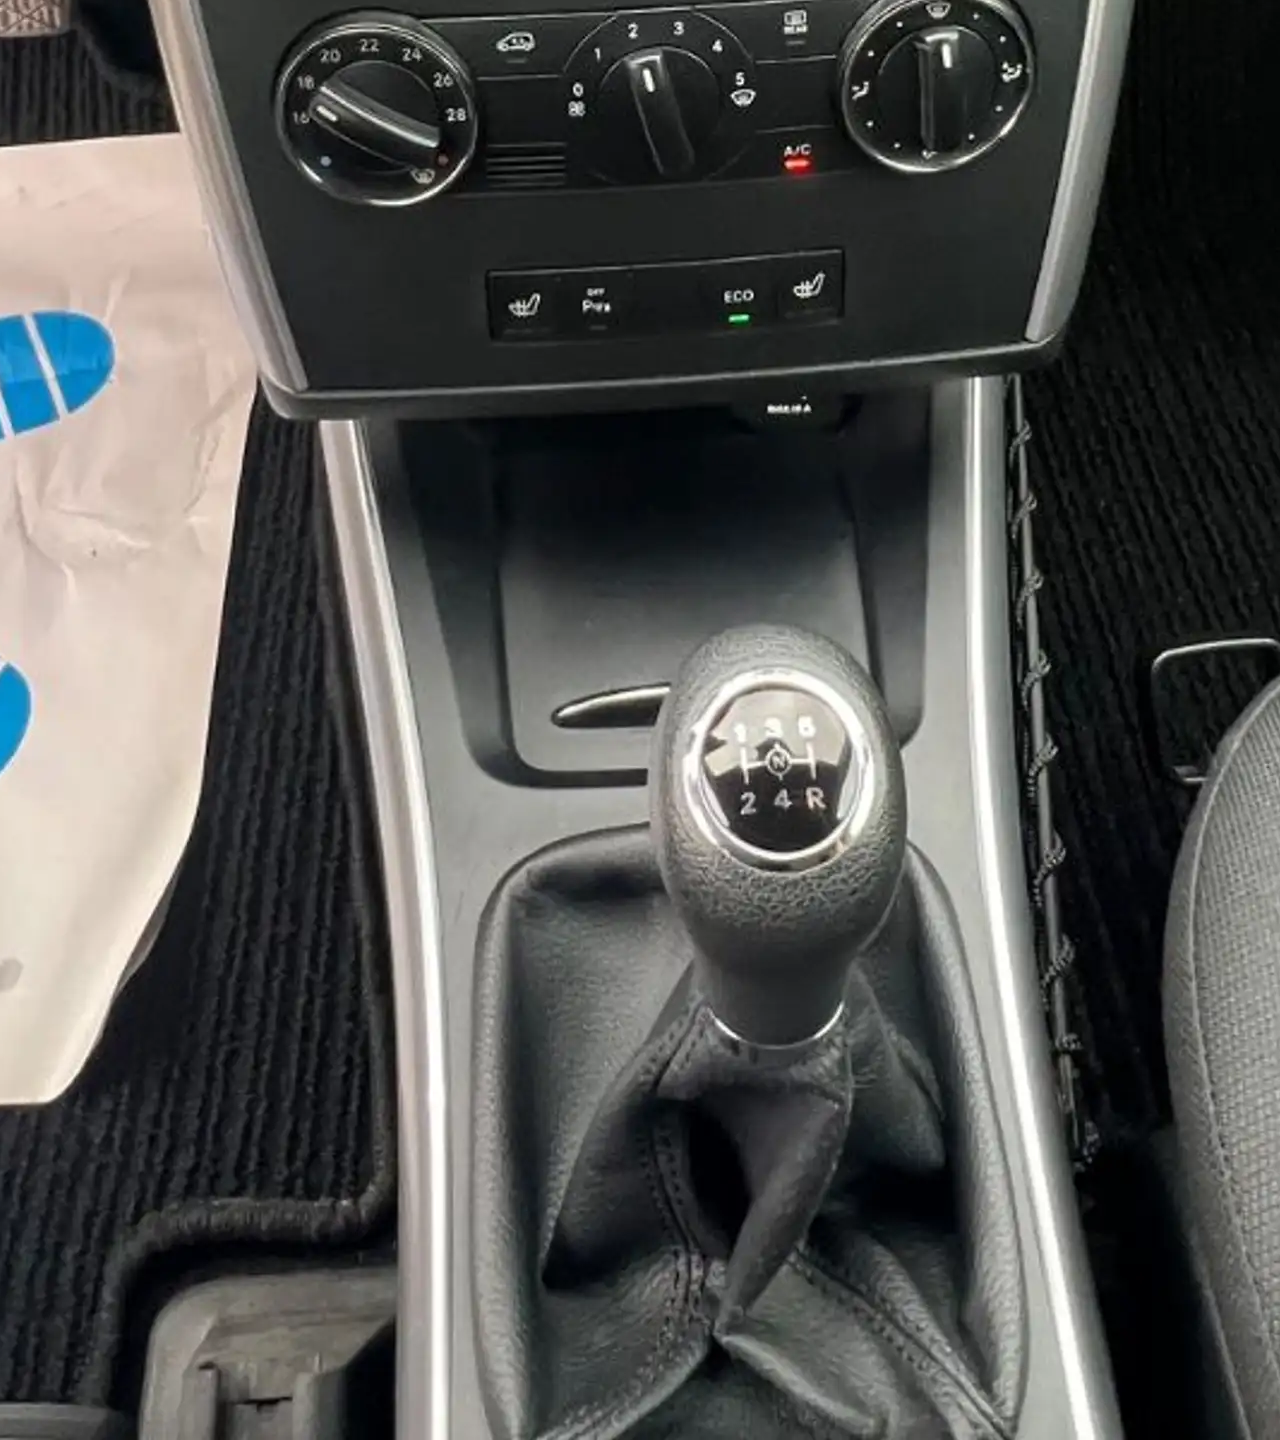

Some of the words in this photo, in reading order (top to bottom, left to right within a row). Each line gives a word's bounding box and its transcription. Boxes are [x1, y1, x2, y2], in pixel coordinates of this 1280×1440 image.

[627, 23, 639, 40] 2
[673, 21, 685, 36] 3
[358, 39, 380, 53] 22
[712, 39, 723, 53] 4
[320, 49, 341, 63] 20
[402, 48, 422, 62] 24
[594, 47, 601, 61] 1
[297, 75, 315, 90] 18
[433, 72, 454, 88] 26
[735, 72, 745, 86] 5
[573, 82, 584, 97] 0
[293, 111, 310, 125] 16
[445, 108, 467, 122] 28
[784, 144, 812, 157] A/C
[723, 289, 755, 305] ECO
[740, 791, 756, 815] 2
[774, 789, 792, 809] 4
[806, 787, 826, 810] R
